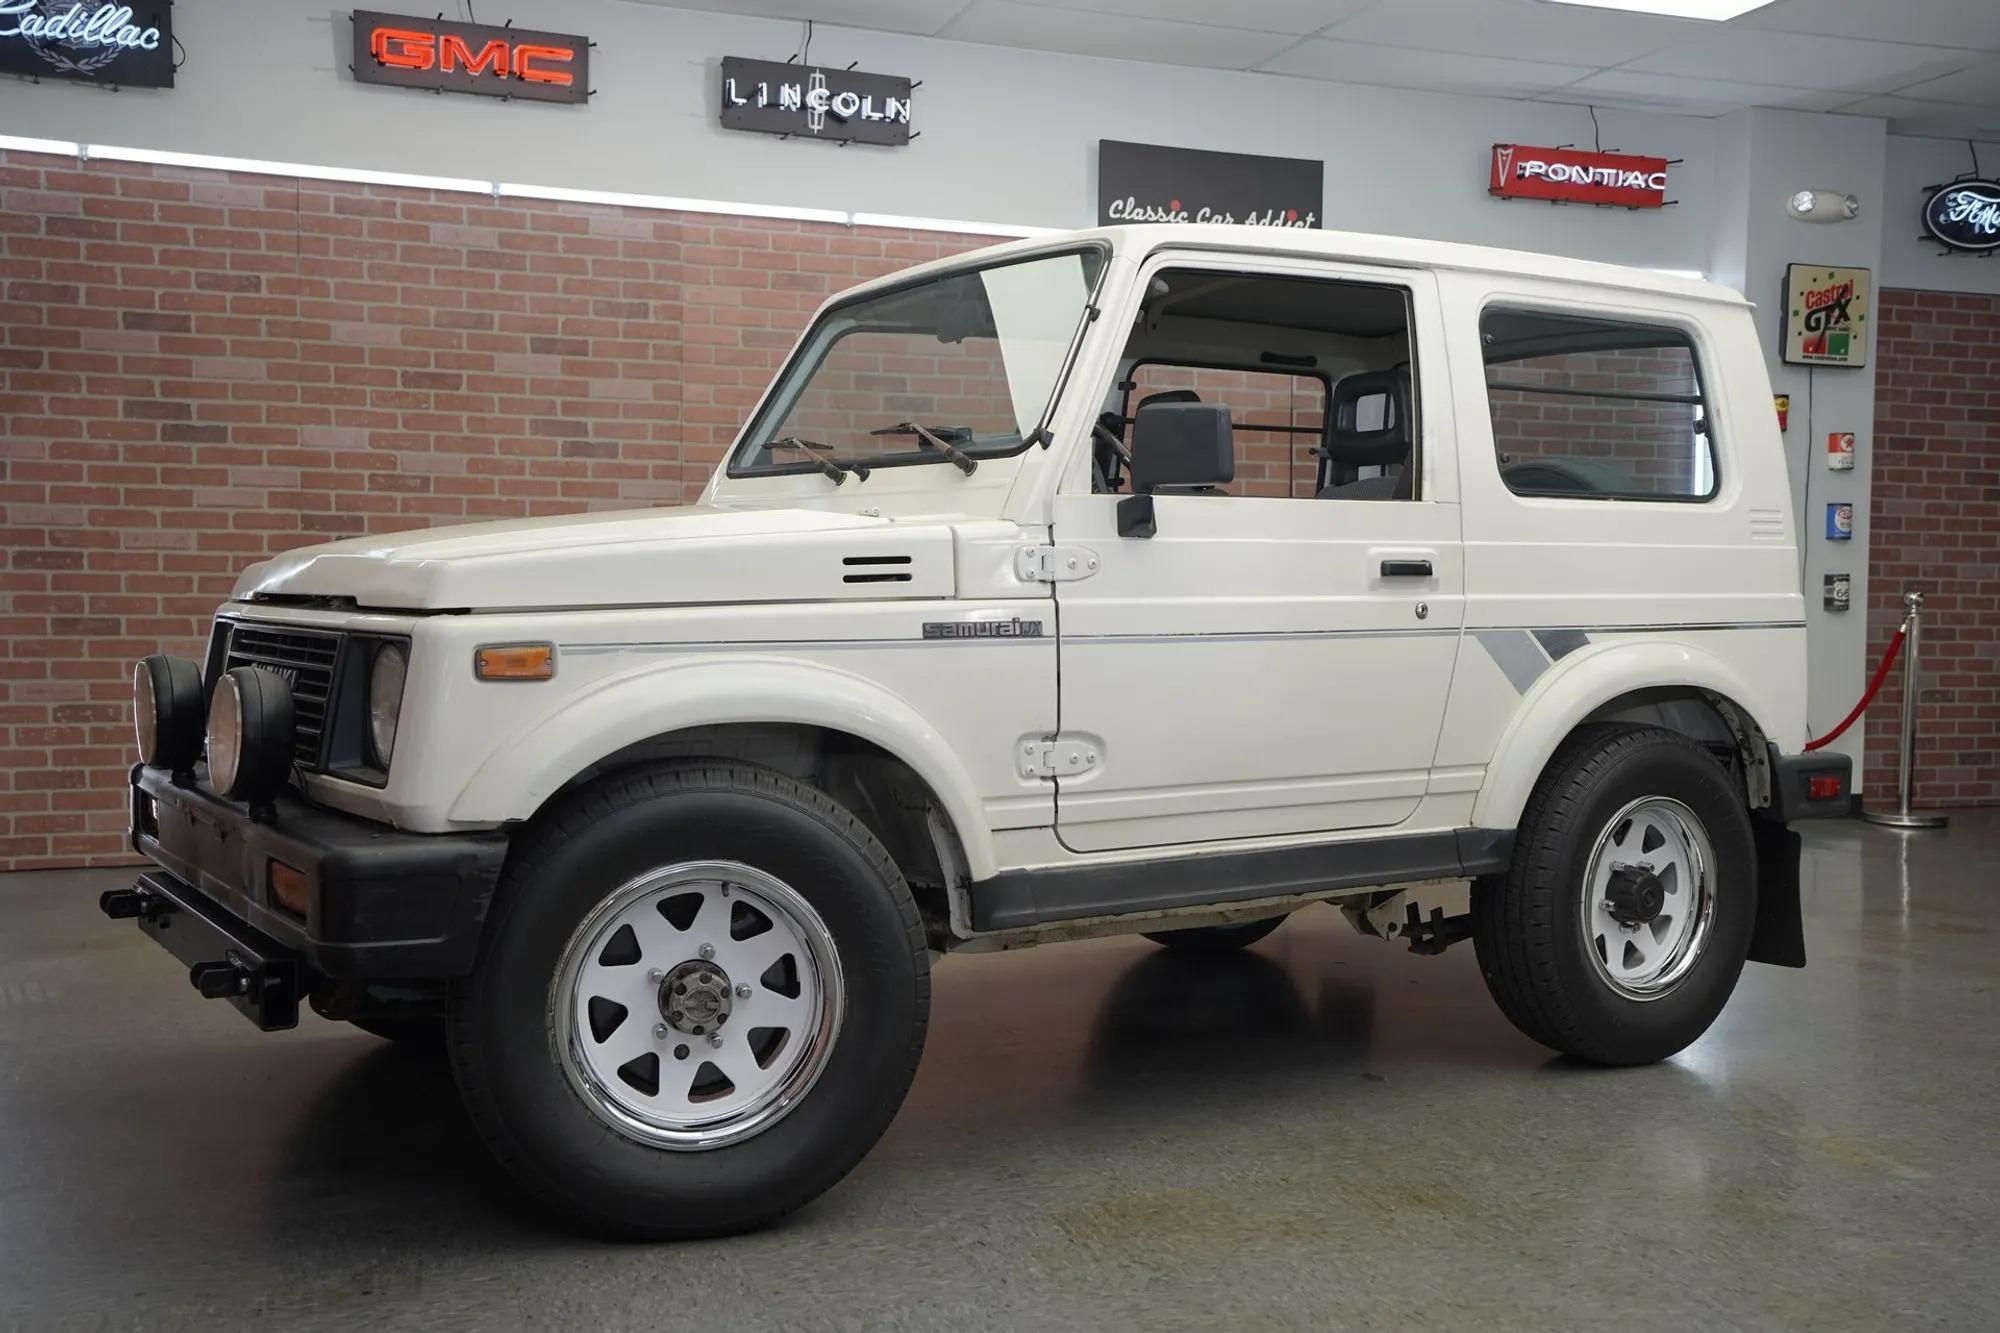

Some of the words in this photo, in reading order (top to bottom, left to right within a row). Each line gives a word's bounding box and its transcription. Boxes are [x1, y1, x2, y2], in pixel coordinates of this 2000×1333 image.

[370, 27, 574, 85] GMC
[725, 77, 910, 123] LINCOLN
[1519, 160, 1667, 190] PONTIAC
[1108, 197, 1189, 224] Classic
[1197, 207, 1234, 225] Car
[1804, 292, 1852, 338] GTX
[923, 617, 1021, 637] samurai
